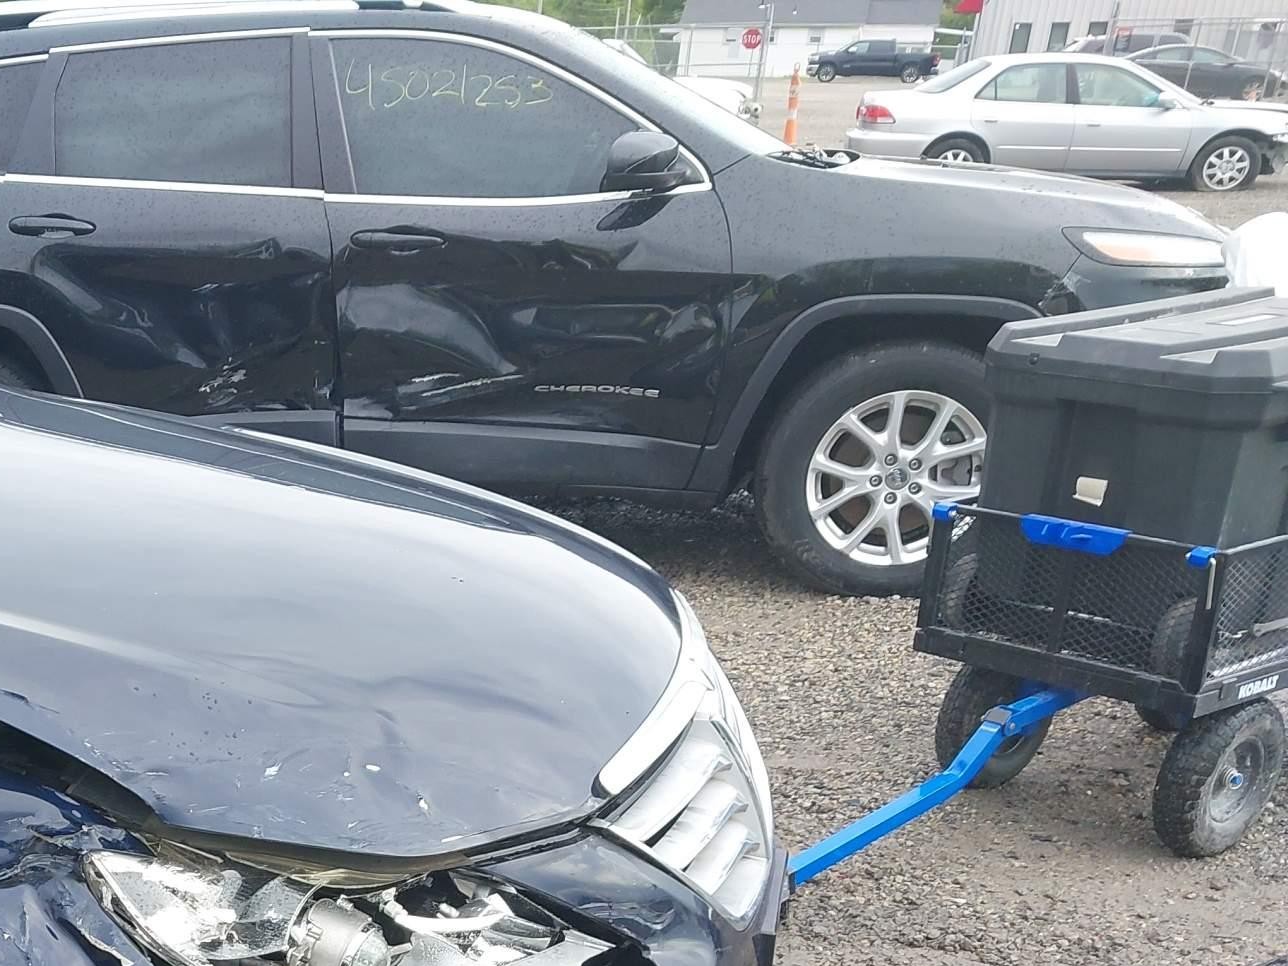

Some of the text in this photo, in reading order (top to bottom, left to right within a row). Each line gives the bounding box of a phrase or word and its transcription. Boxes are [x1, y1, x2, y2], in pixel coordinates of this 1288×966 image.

[743, 34, 761, 44] STOP
[345, 57, 554, 110] 45021253
[534, 385, 660, 398] CHEROKEE
[1238, 675, 1280, 699] KOBALT
